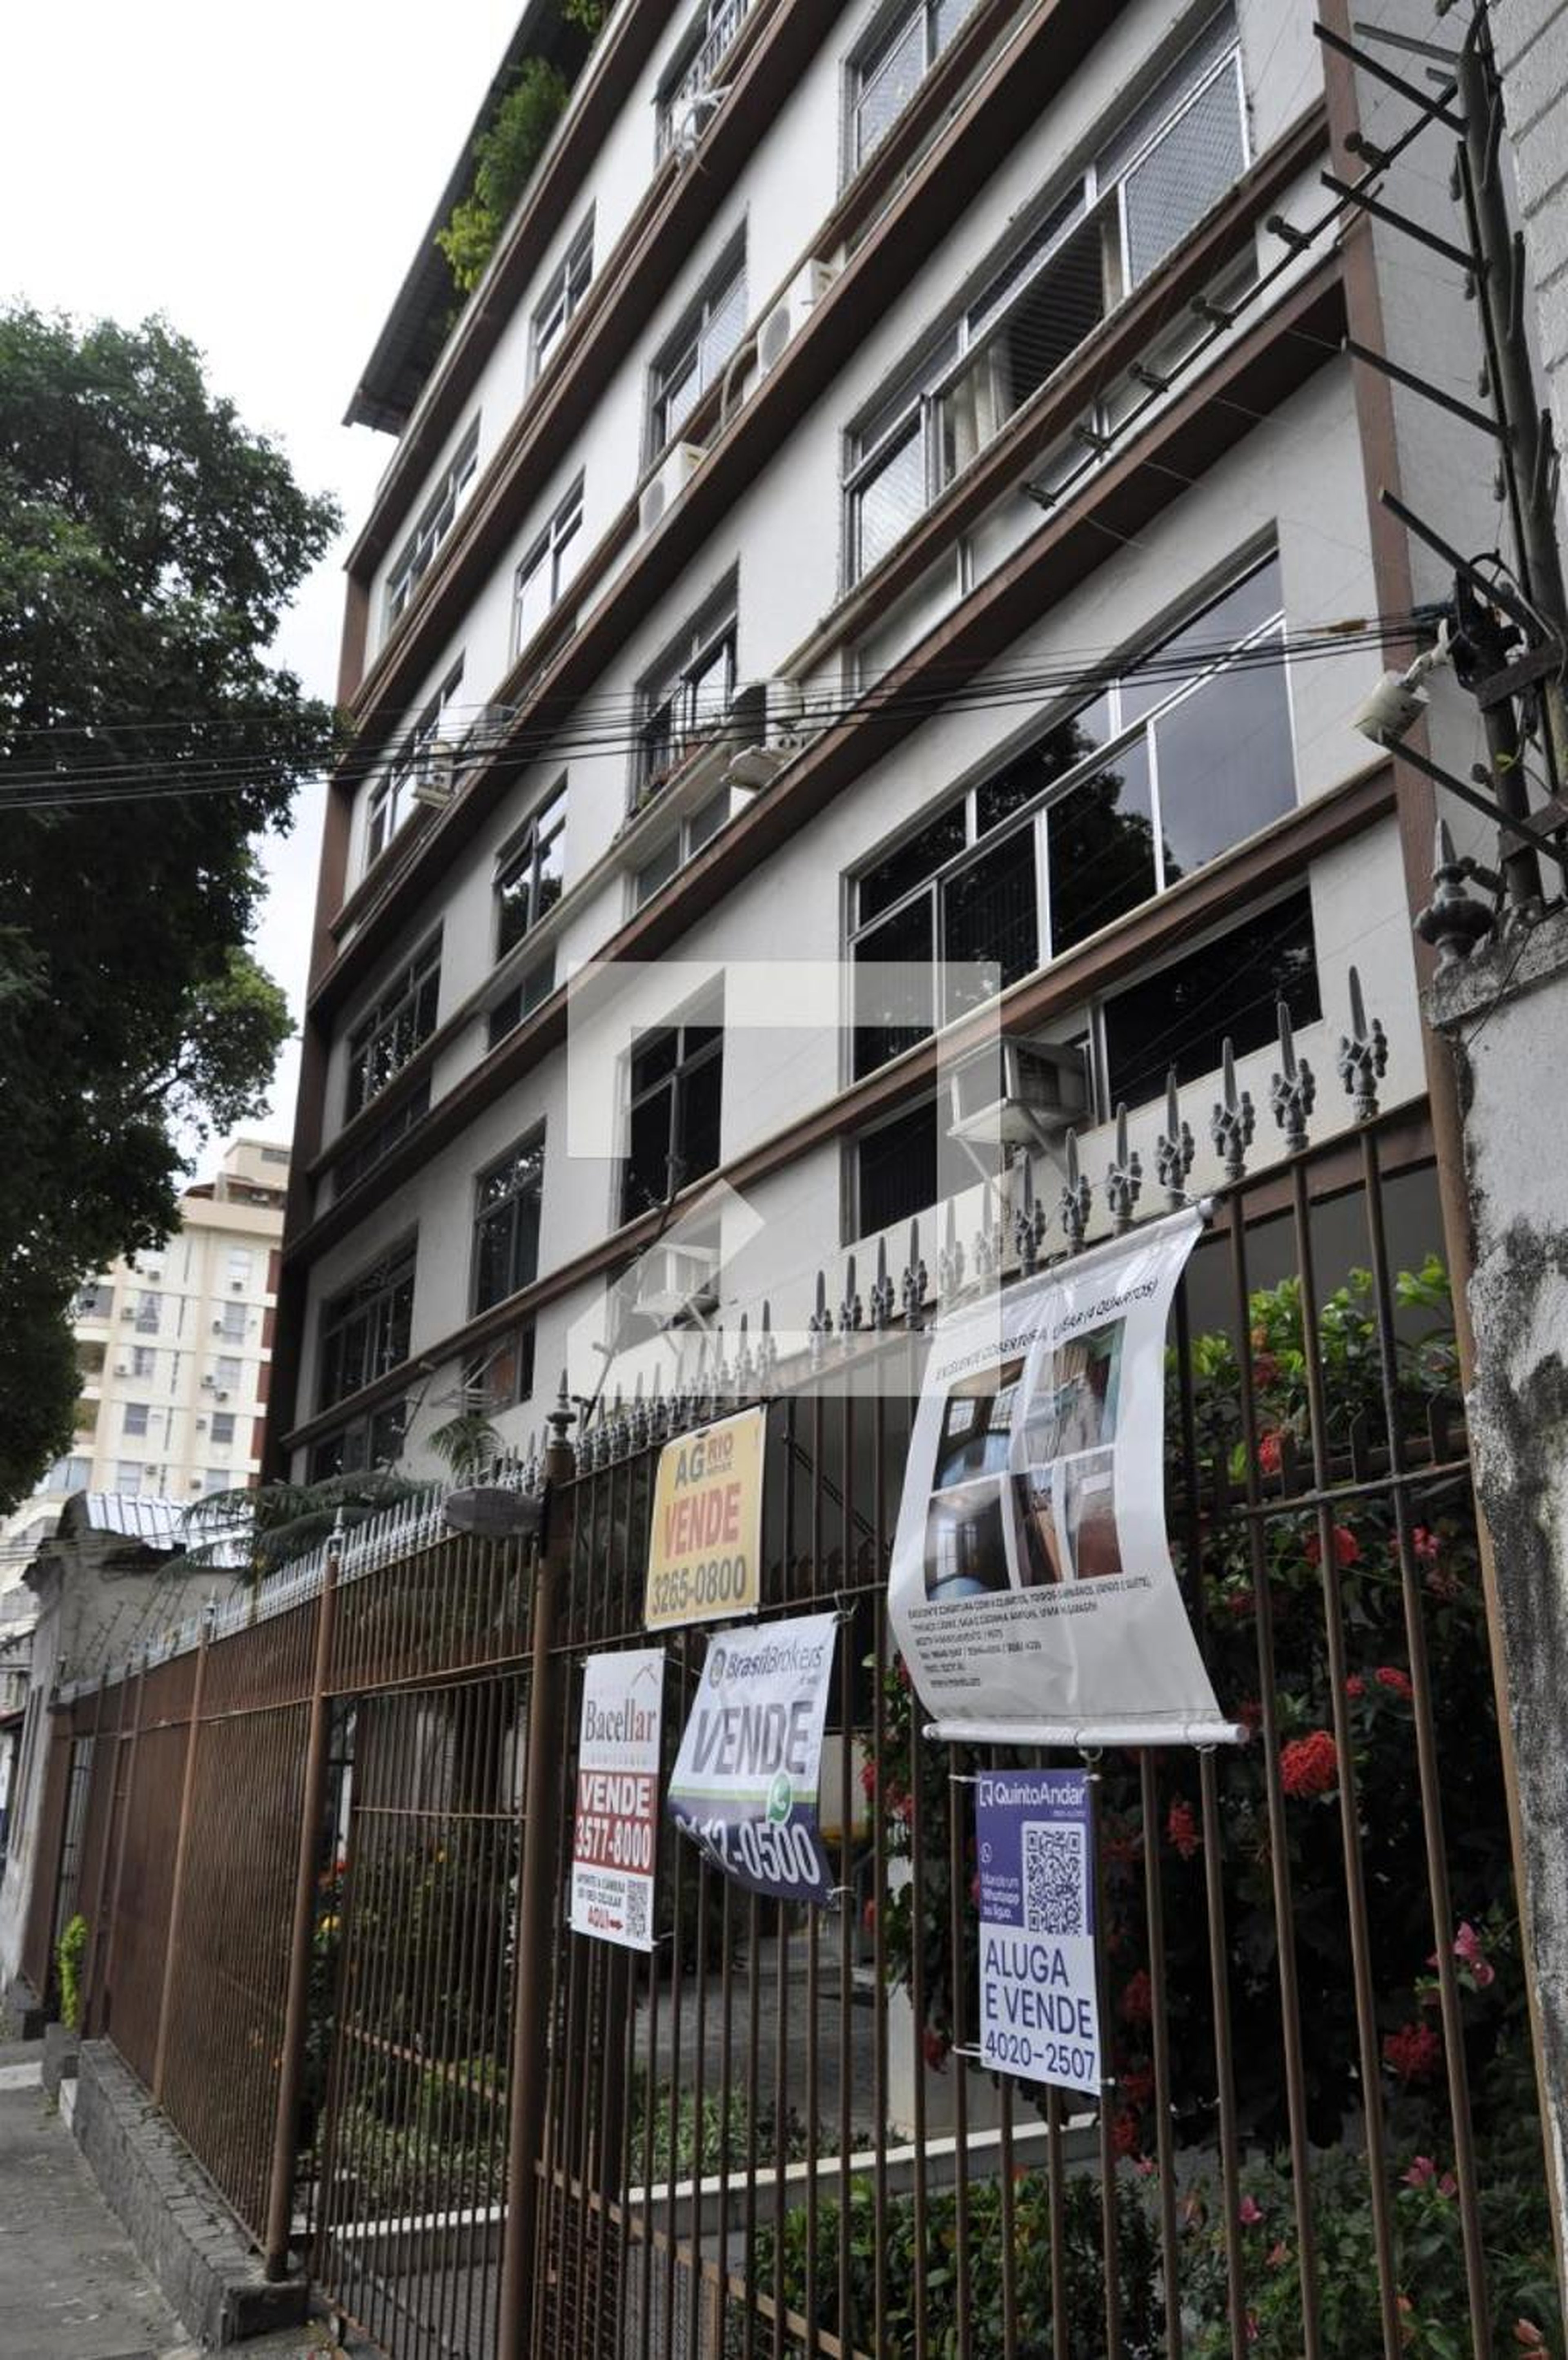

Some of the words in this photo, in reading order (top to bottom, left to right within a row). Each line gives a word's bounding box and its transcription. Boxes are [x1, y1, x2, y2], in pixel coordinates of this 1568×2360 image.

[675, 1443, 705, 1491] AG
[707, 1433, 734, 1461] RIO
[664, 1482, 742, 1559] VENDE
[653, 1555, 747, 1615] 3265-0800
[726, 1640, 824, 1679] BrasilBrokers
[585, 1698, 657, 1743] Bacellar
[691, 1700, 815, 1775] VENDE
[580, 1773, 650, 1818] VENDE
[995, 1781, 1085, 1805] QuintoAndar
[576, 1815, 651, 1870] 3577-8000
[985, 1939, 1069, 1988] ALUGA
[986, 1982, 998, 2019] E
[1004, 1986, 1093, 2039] VENDE
[984, 2030, 1095, 2081] 4020-2507
